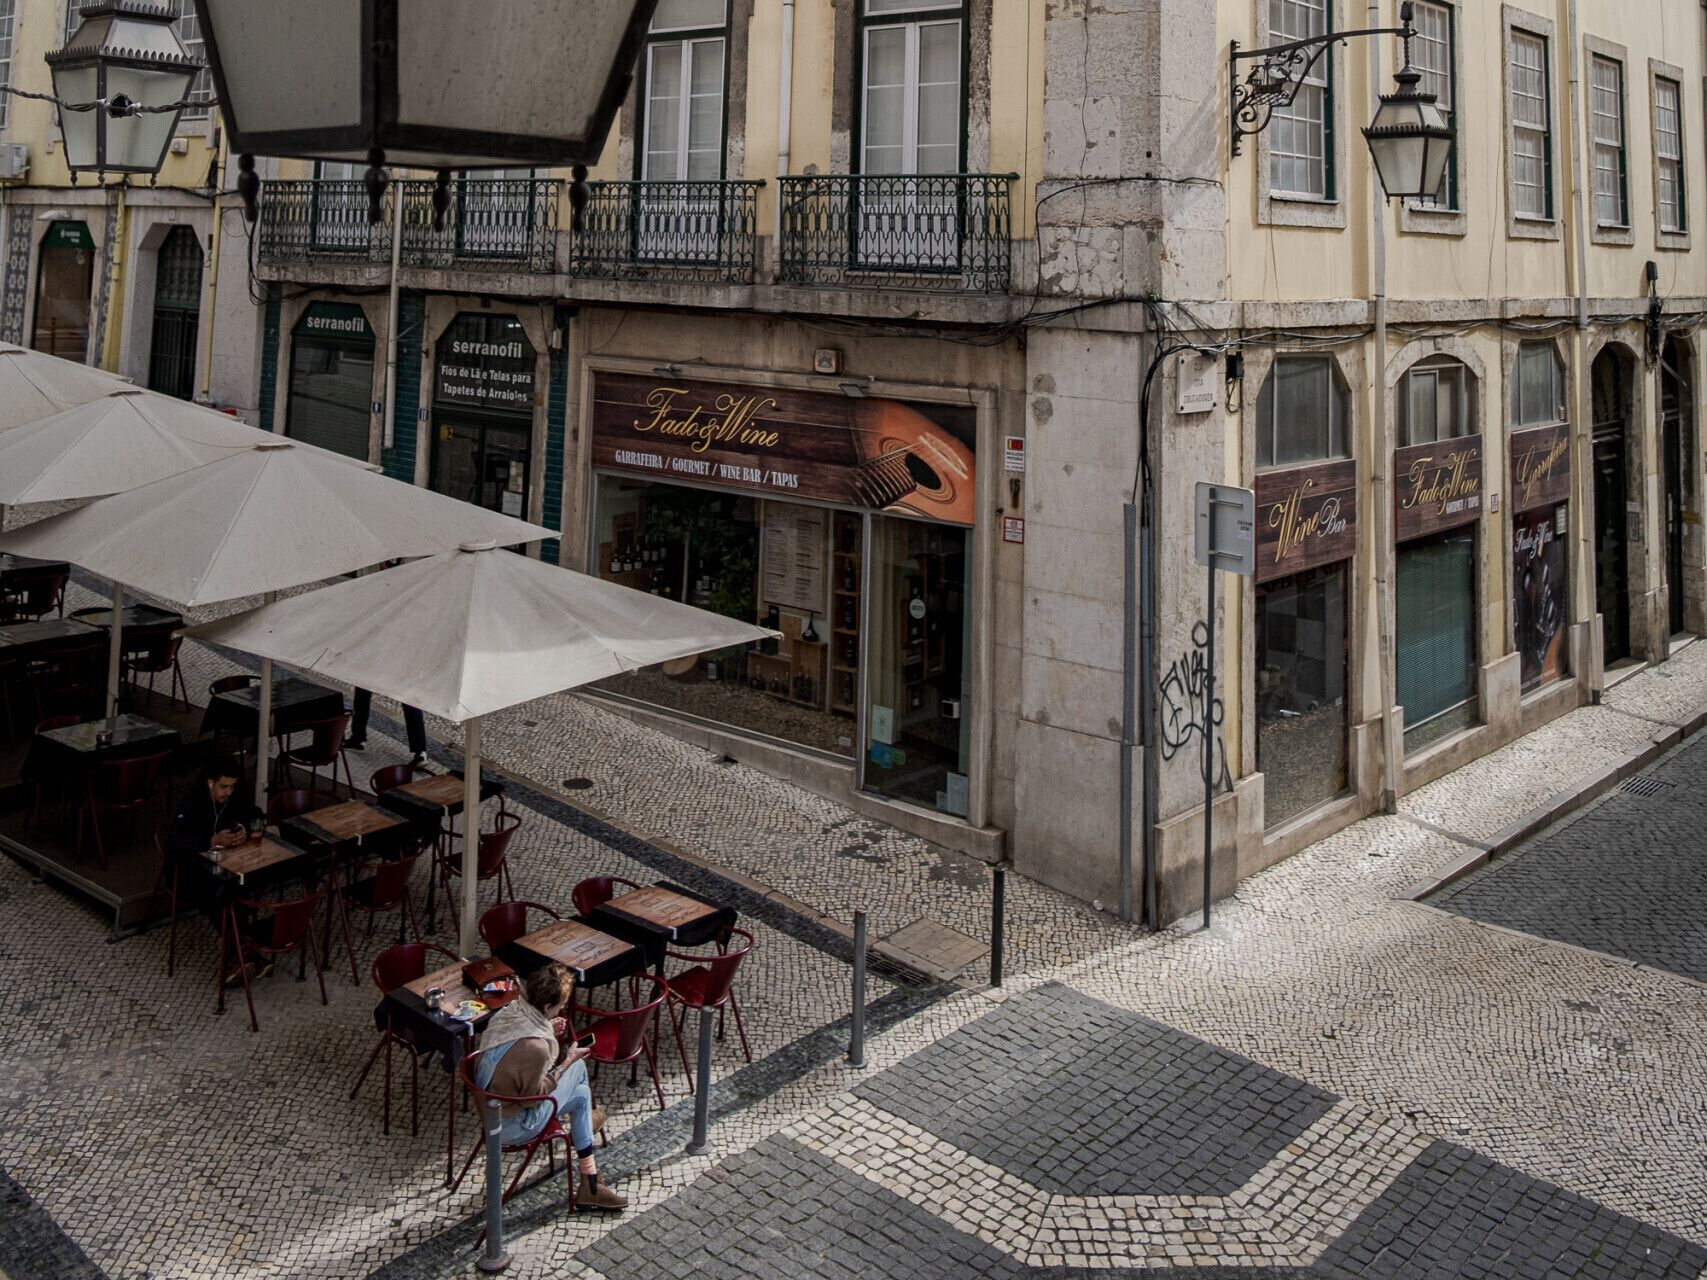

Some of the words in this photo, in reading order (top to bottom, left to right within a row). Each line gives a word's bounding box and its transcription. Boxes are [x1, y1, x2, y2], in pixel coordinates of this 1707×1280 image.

[307, 316, 364, 332] serranofil
[452, 340, 523, 359] serranofil
[441, 365, 457, 377] Fios
[459, 367, 469, 378] de
[481, 371, 488, 380] e
[490, 370, 510, 382] Telas
[512, 373, 531, 385] para
[443, 383, 474, 397] Tapetes
[476, 387, 486, 398] de
[488, 388, 527, 402] Arraiolos
[615, 449, 662, 469] GARRAFEIRA
[672, 457, 710, 476] GOURMET
[720, 464, 741, 480] WINE
[743, 468, 761, 483] BAR
[772, 471, 798, 488] TAPAS
[1269, 478, 1319, 563] Wine
[1317, 497, 1347, 537] Bar
